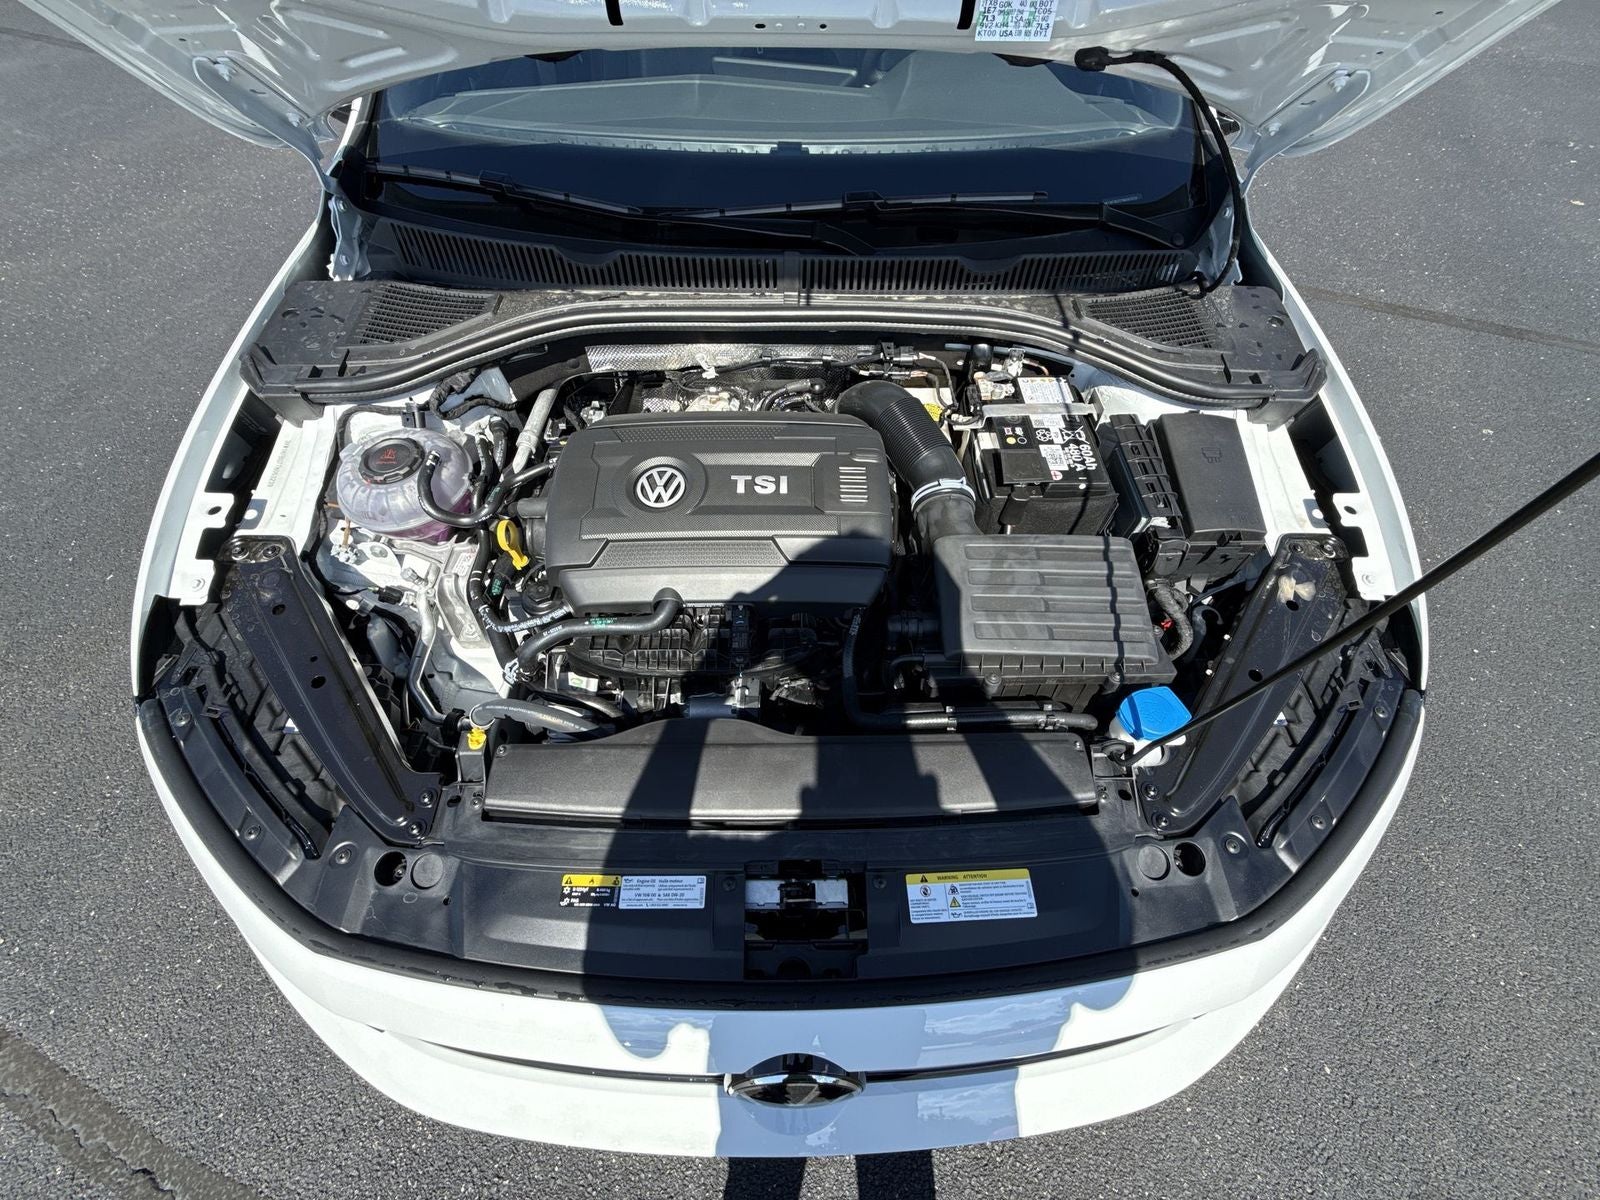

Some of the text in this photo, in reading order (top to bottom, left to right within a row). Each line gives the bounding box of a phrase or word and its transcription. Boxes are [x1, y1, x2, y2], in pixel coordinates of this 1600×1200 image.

[1069, 443, 1083, 462] 480
[1079, 444, 1098, 470] 60Ah
[730, 475, 788, 495] TSI
